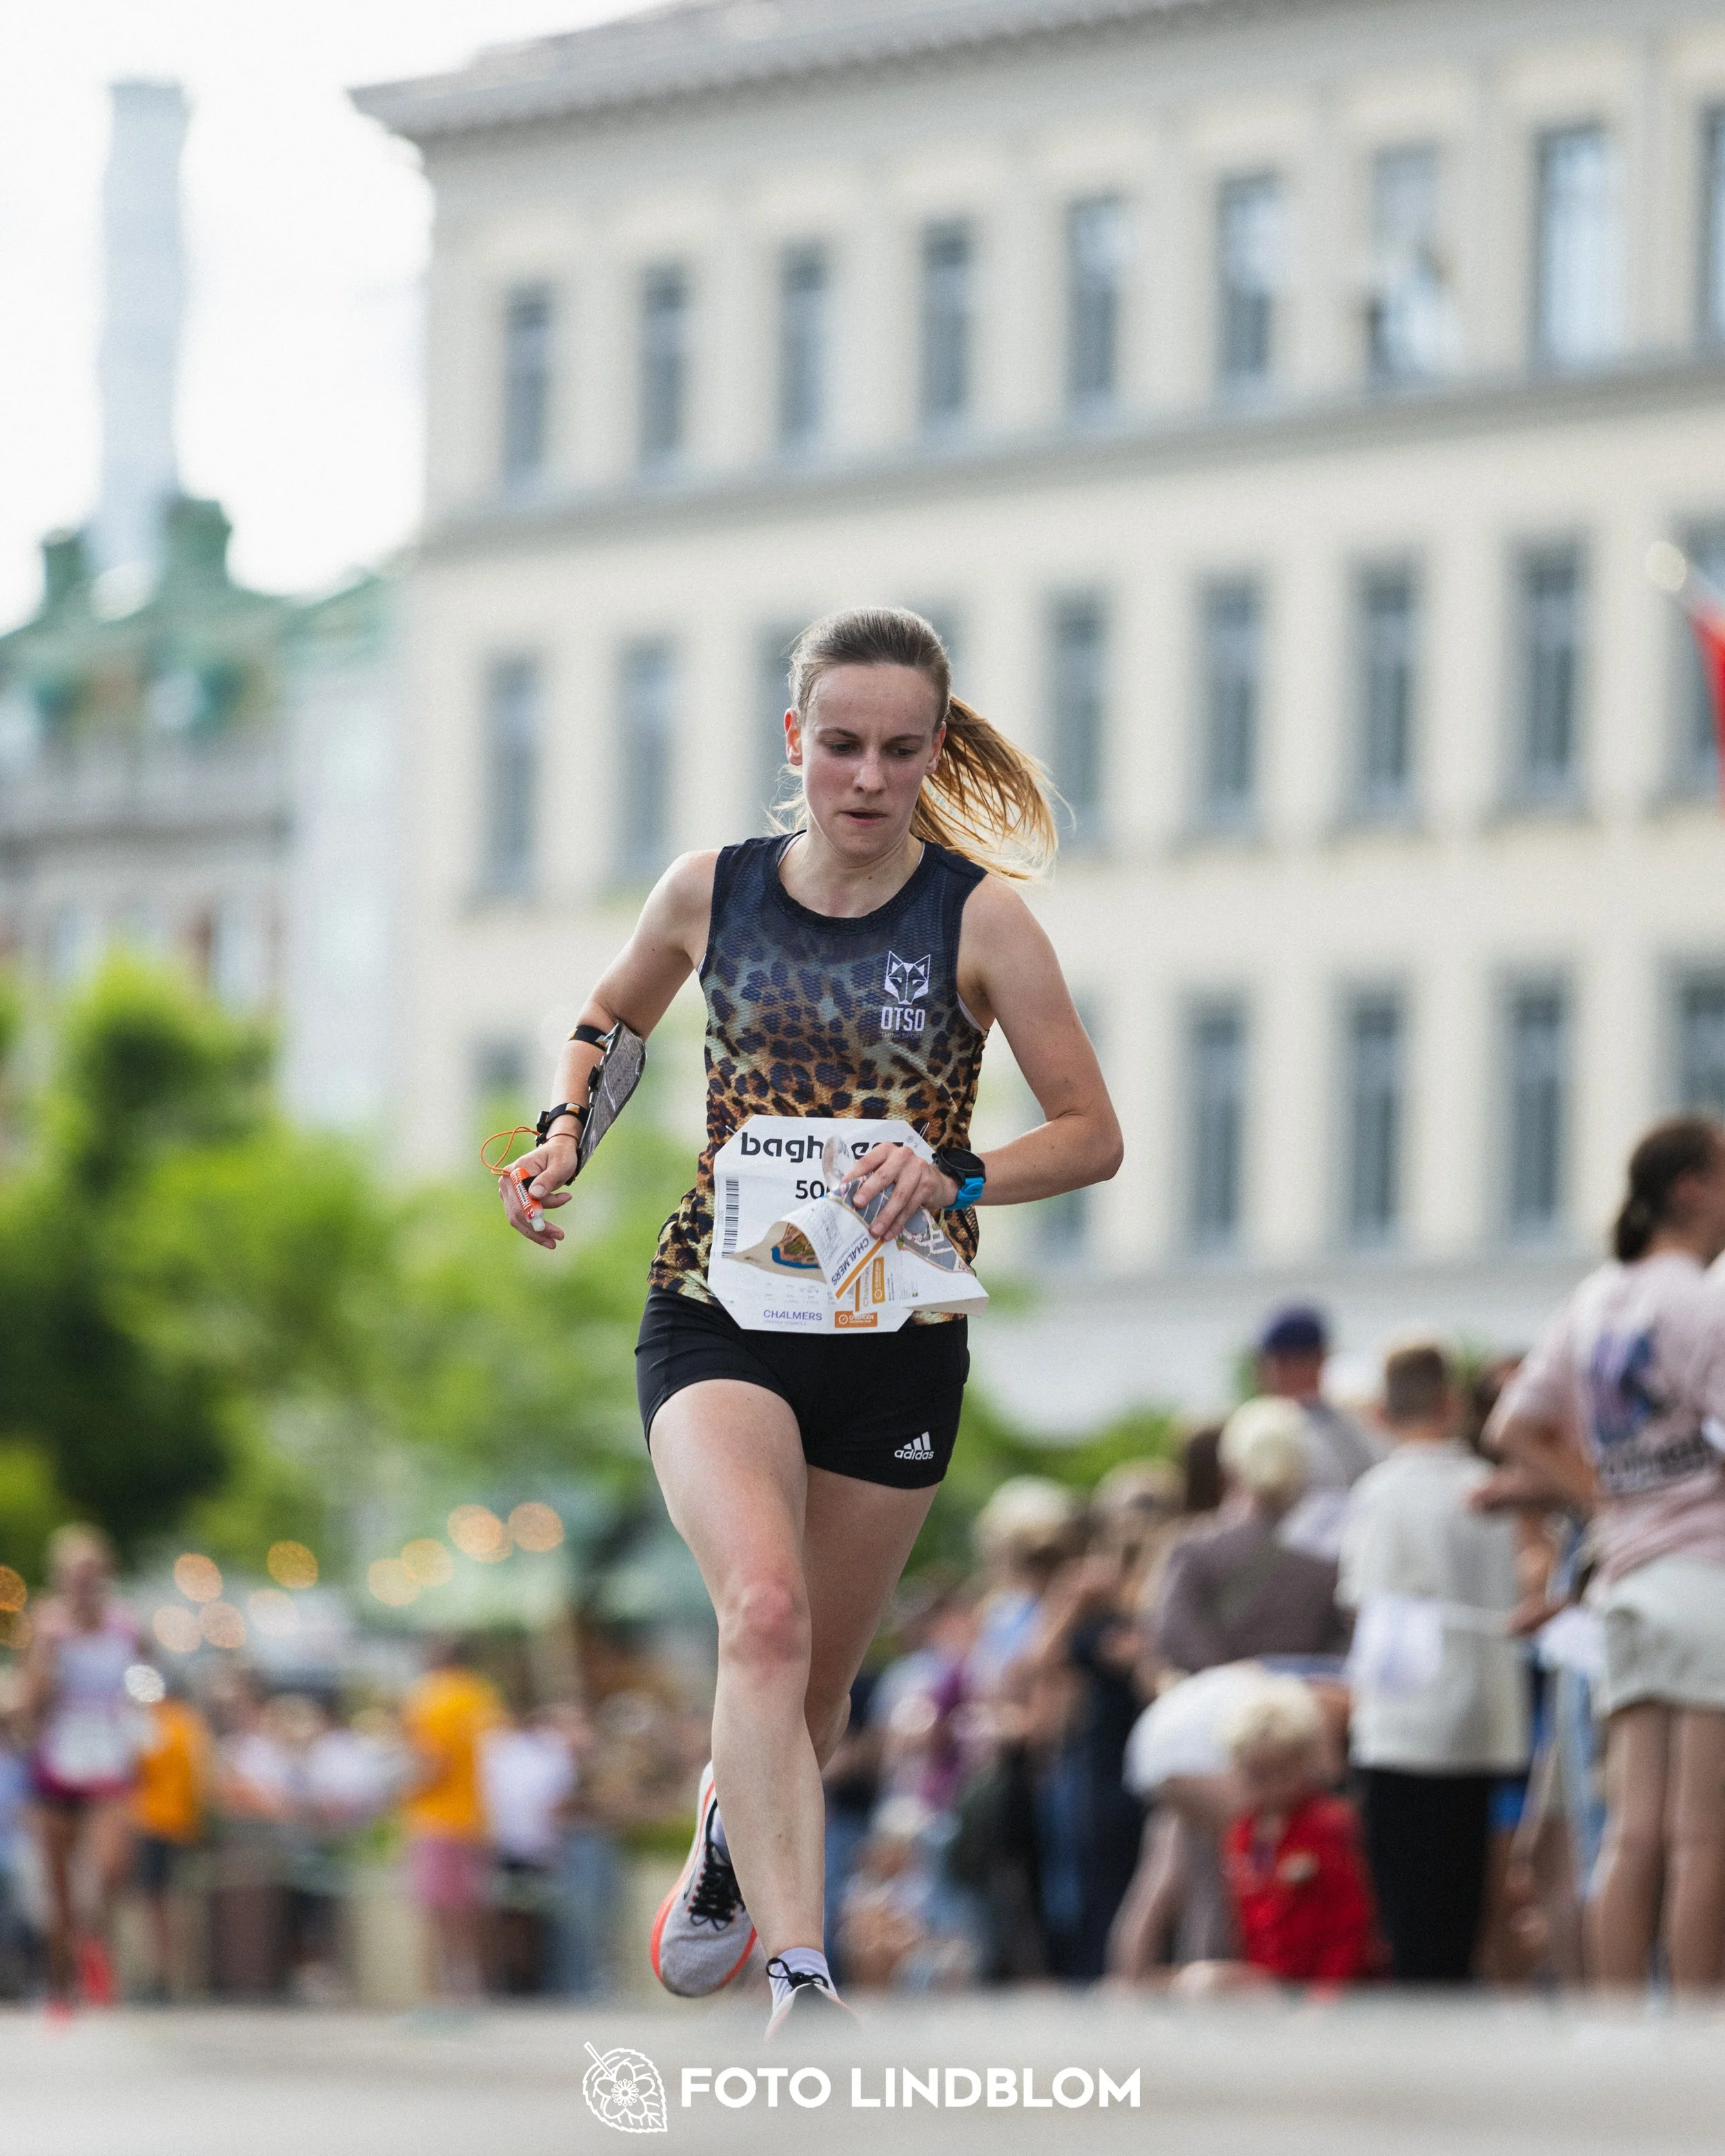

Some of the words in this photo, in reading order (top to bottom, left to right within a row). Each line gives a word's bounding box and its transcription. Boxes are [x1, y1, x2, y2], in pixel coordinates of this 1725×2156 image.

[881, 1007, 925, 1031] OTSO
[795, 1180, 830, 1200] 50
[831, 1237, 869, 1286] CHALMERS
[763, 1309, 822, 1321] CHALMERS
[894, 1449, 934, 1460] adidas
